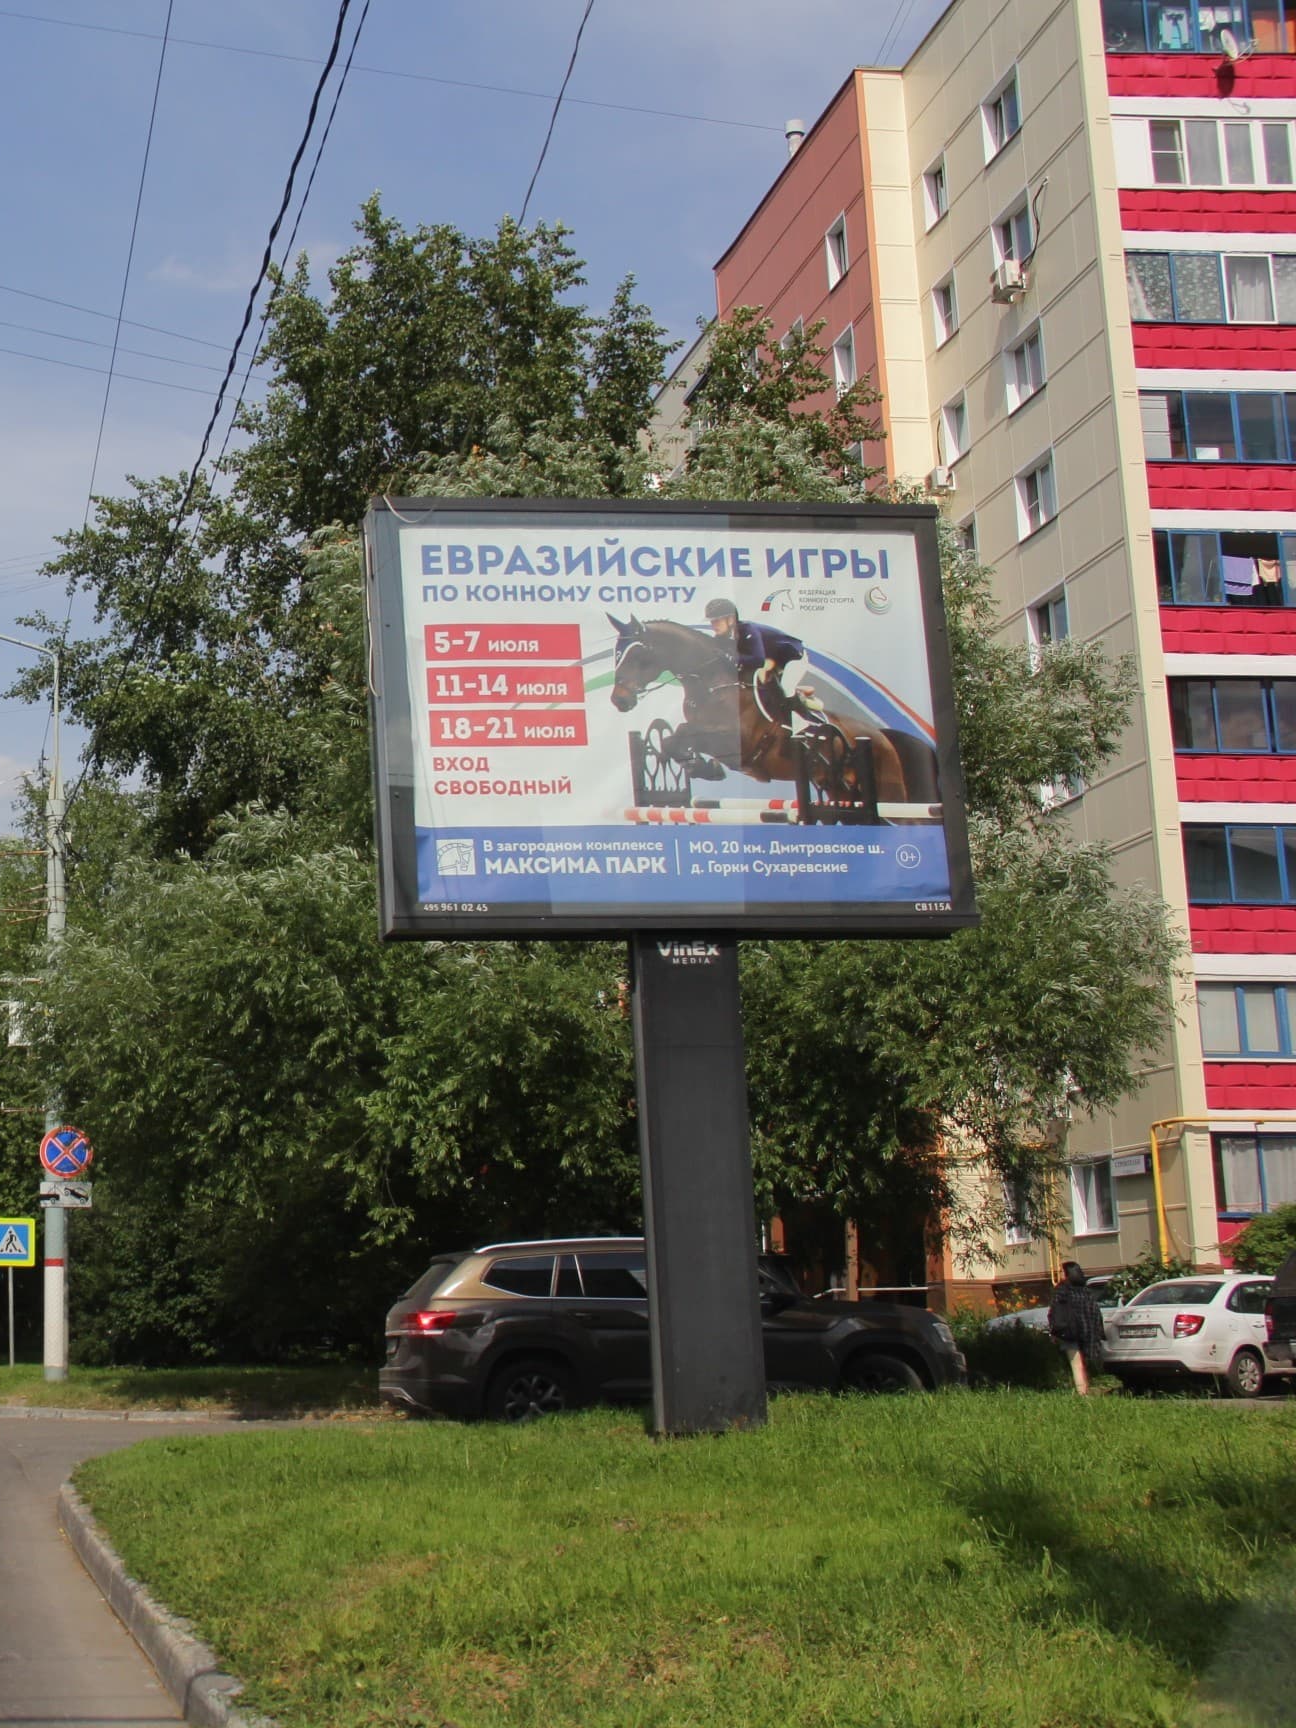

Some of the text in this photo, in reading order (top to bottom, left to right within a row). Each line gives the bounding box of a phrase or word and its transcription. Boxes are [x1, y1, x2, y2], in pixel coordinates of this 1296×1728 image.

[421, 538, 889, 579] ЕВРАЗИЙСКИЕ ИГРЫ
[422, 584, 696, 603] ПО КОННОМУ СПОРТУ
[434, 631, 480, 653] 5-7
[436, 674, 508, 696] 11-14
[440, 717, 517, 739] 18-21
[433, 757, 490, 772] ВХОД
[434, 776, 572, 795] СВОБОДНЫЙ
[483, 840, 663, 854] В загородном комплексе
[689, 841, 885, 857] МО, 20 км. Дмитровское ш.
[899, 850, 917, 863] 0+
[485, 857, 667, 874] МАКСИМА ПАРК
[691, 861, 848, 877] д. Горки Сухаревские
[423, 903, 488, 912] 495 961 02 45
[672, 957, 711, 965] MEDIA
